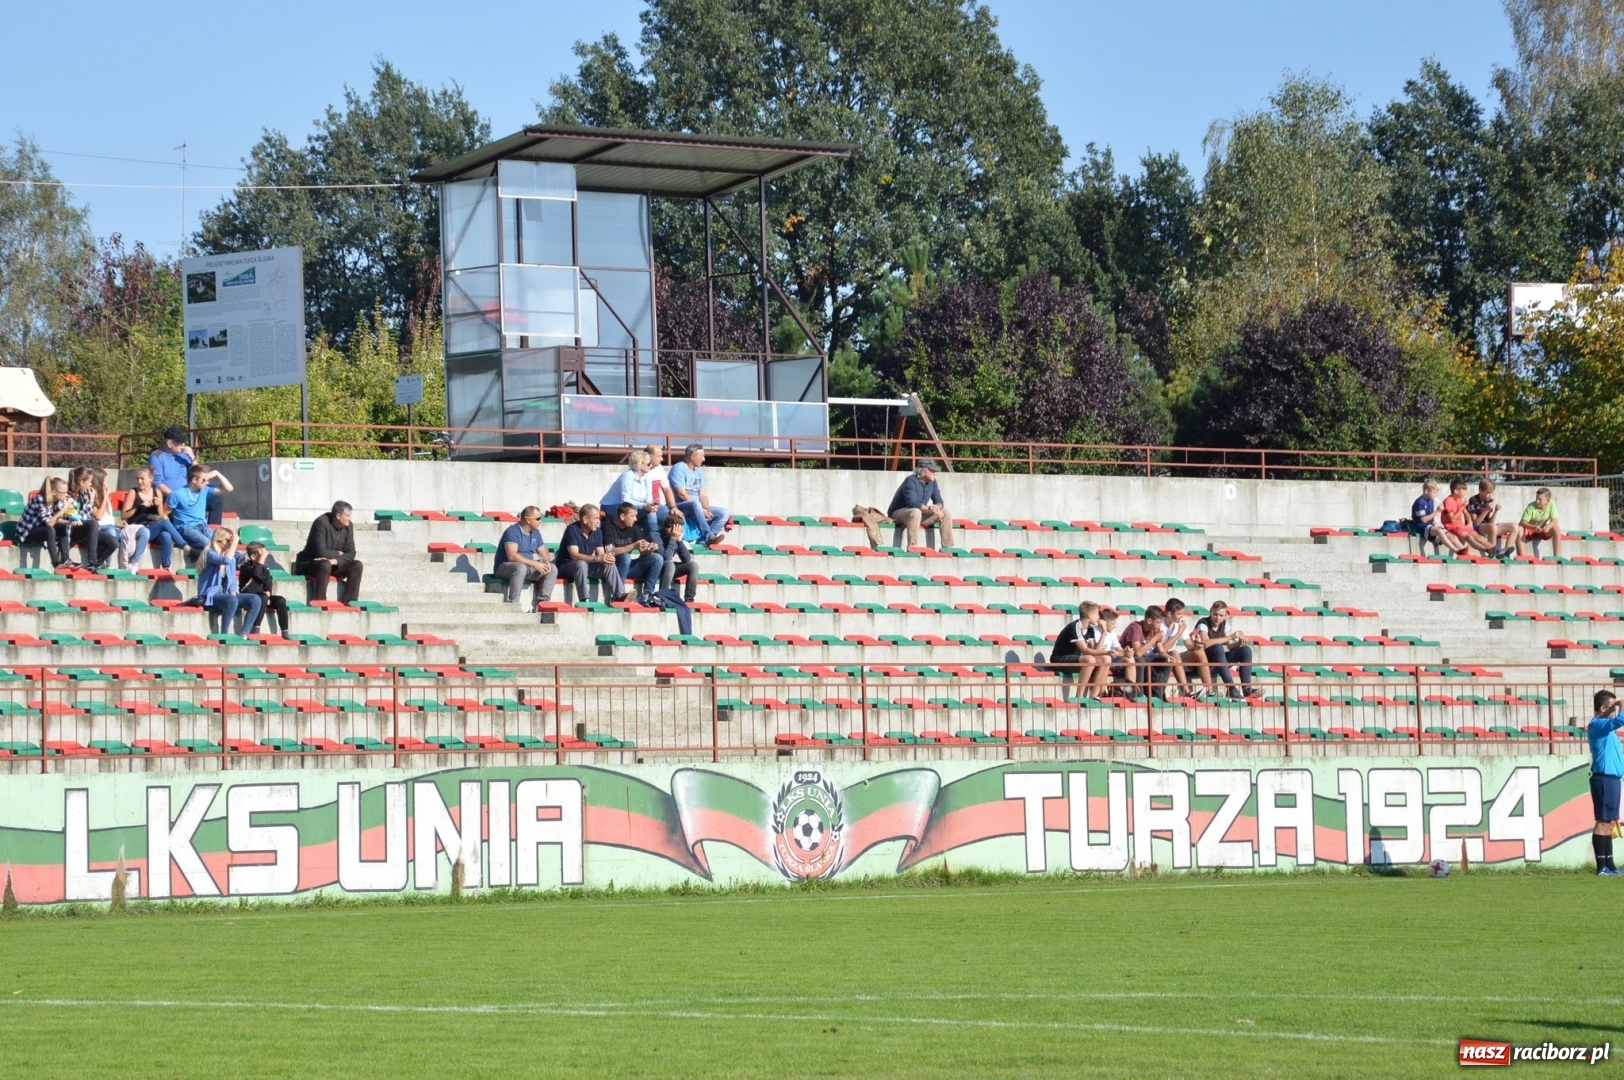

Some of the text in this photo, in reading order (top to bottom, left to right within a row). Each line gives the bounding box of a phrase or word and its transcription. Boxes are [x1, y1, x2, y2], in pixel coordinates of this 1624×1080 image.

[258, 463, 270, 482] C
[278, 463, 293, 482] C
[797, 772, 819, 783] 1924
[780, 788, 835, 819] LKS UNIA
[64, 766, 1544, 901] LKS UNIA TURZA 1924
